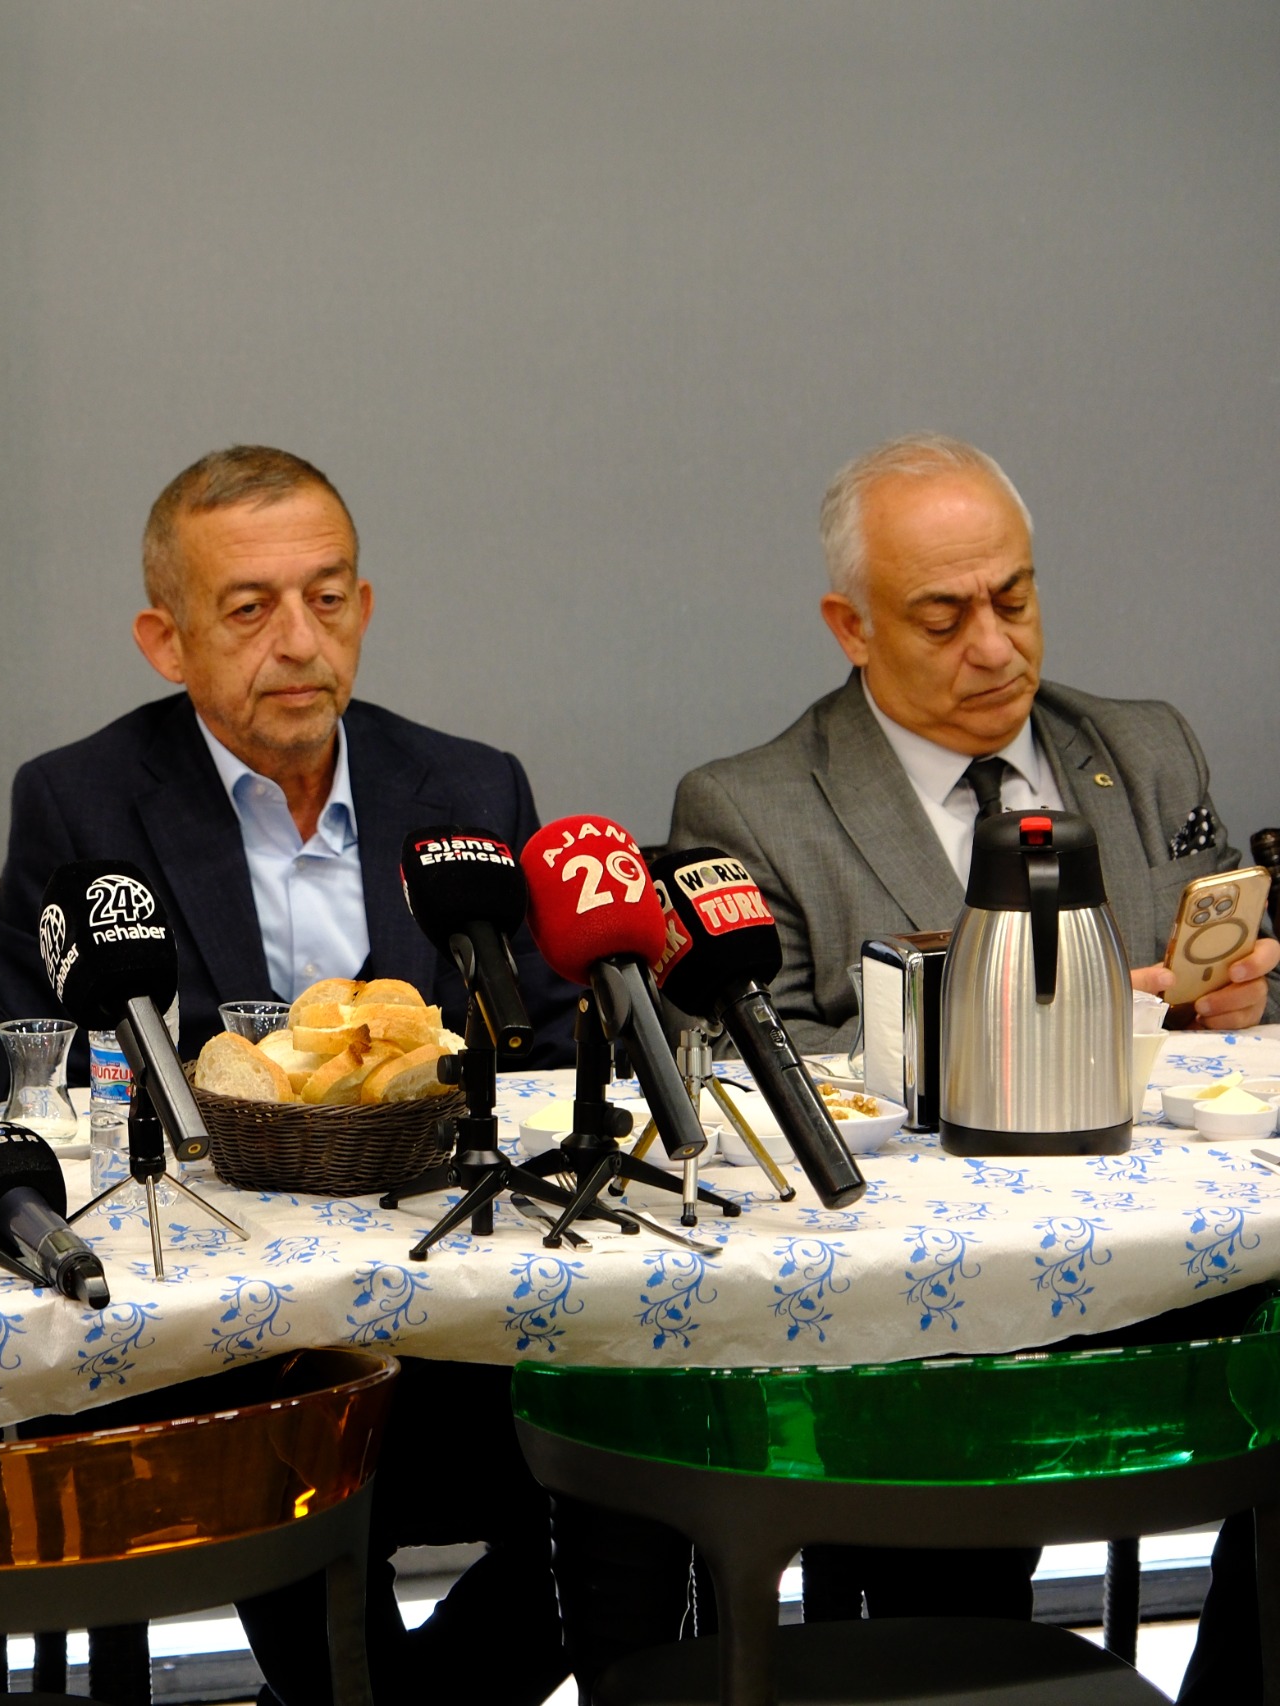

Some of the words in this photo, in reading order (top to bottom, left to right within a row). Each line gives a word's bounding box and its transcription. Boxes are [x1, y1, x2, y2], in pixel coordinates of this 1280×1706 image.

[420, 850, 516, 868] Erzincan
[427, 837, 496, 853] ajans
[542, 822, 641, 868] AJANS
[561, 850, 647, 915] 29
[679, 863, 749, 892] WORLD
[86, 882, 139, 927] 24
[699, 890, 772, 929] TÜRK
[92, 923, 166, 945] nehaber
